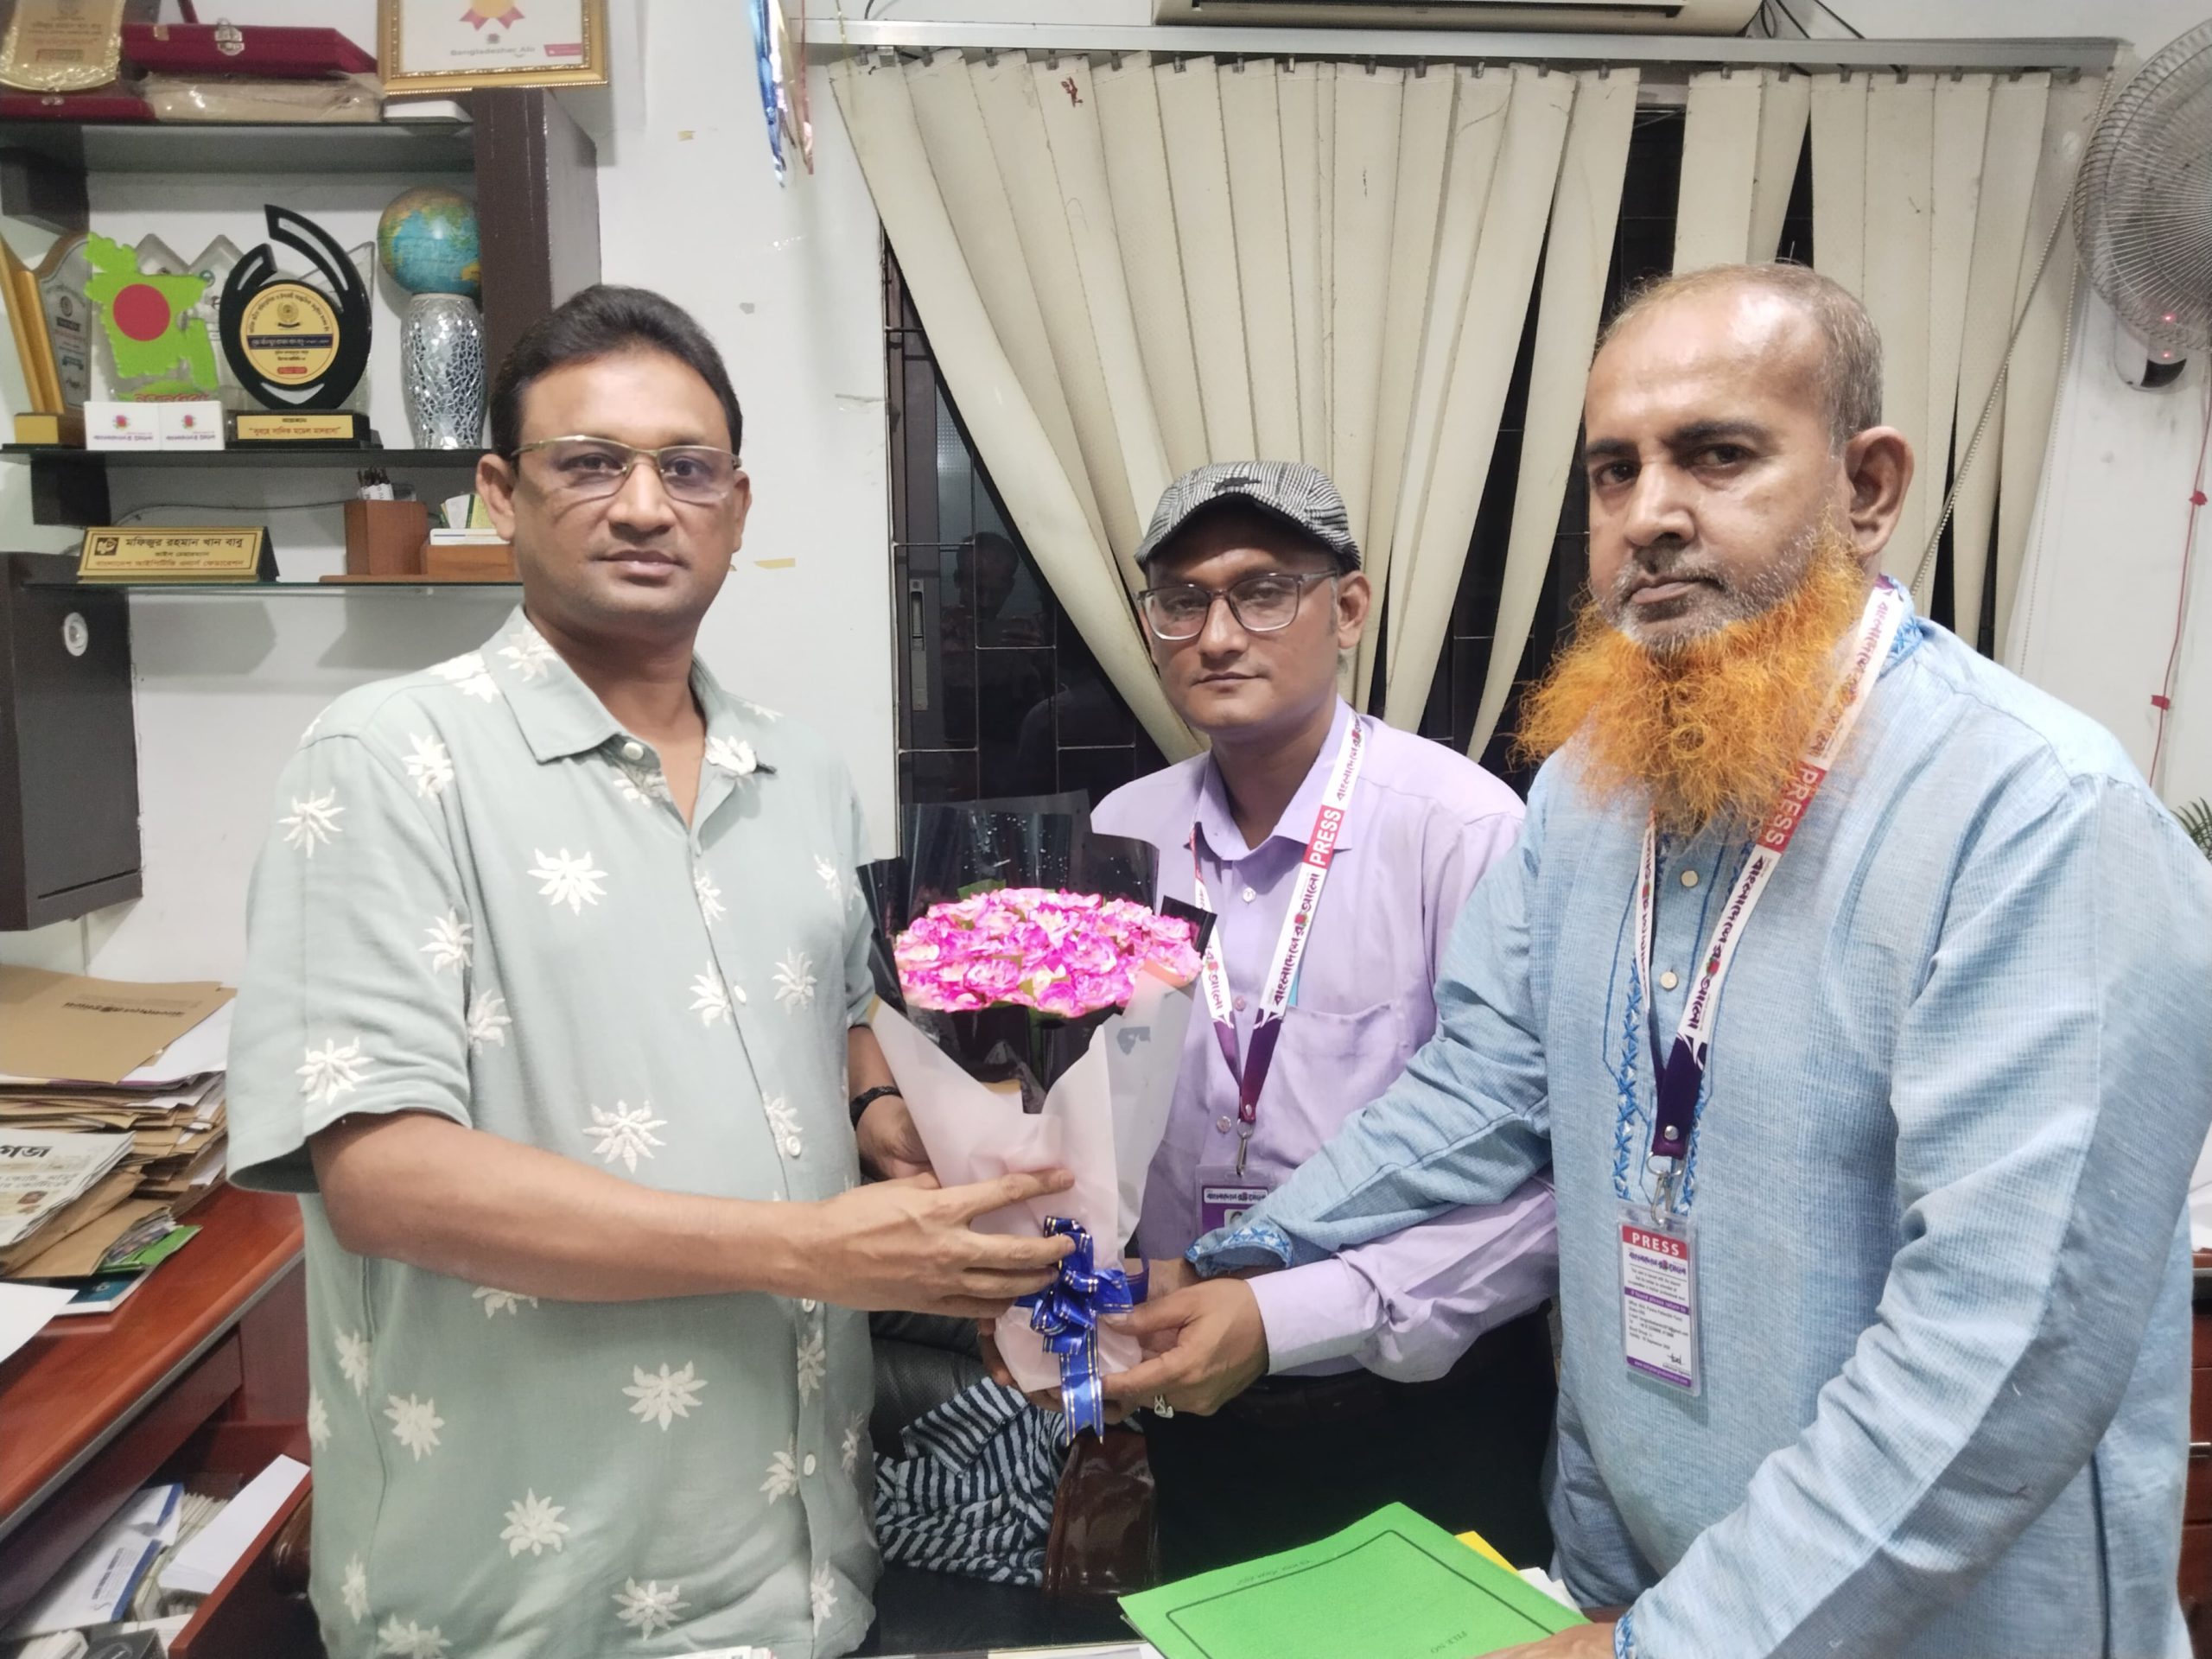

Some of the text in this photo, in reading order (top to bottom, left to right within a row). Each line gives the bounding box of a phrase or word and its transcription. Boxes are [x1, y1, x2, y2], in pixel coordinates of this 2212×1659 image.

[450, 48, 516, 57] Bangladesher
[125, 536, 245, 550] মফিজুর রহমান খান বাবু
[1764, 767, 1818, 845] PRESS
[1308, 808, 1344, 867] PRESS
[1274, 873, 1320, 1007] বাংলাদেশের আলো
[1688, 855, 1765, 1030] বাংলাদেশের আলো
[1207, 973, 1223, 1011] আলো
[1631, 1231, 1680, 1256] PRESS
